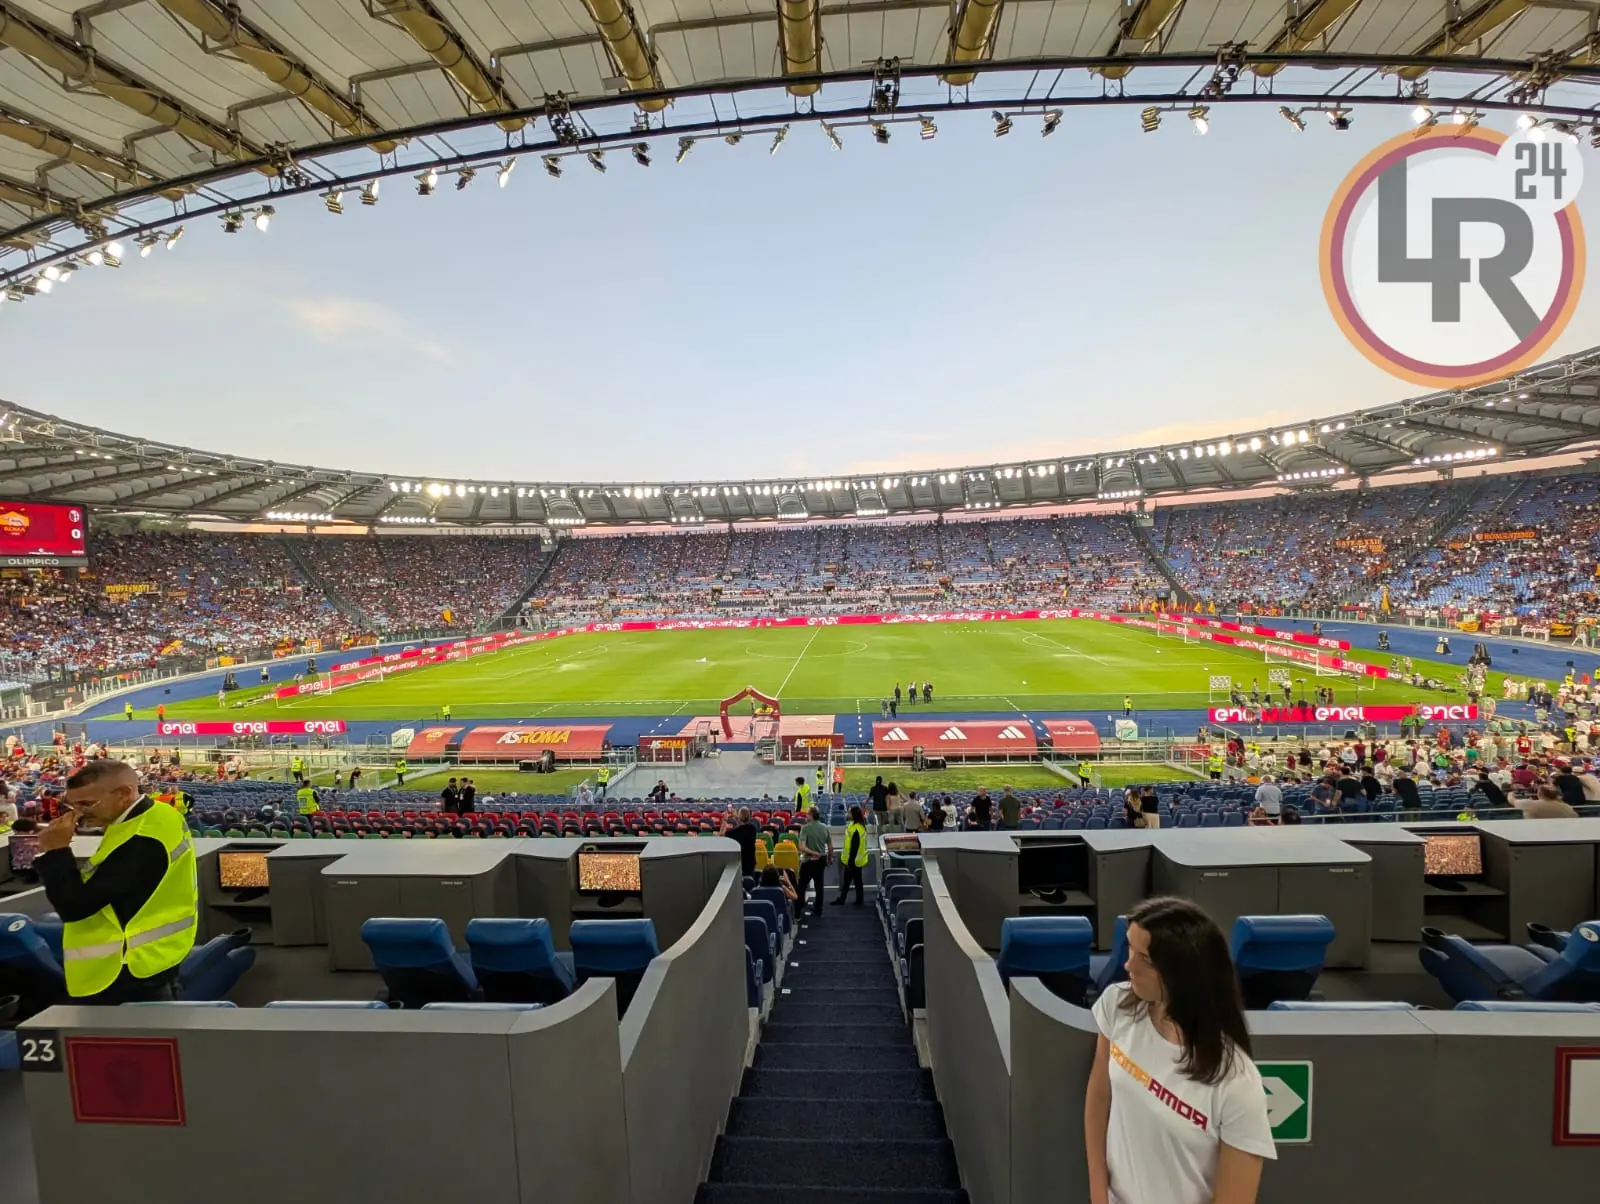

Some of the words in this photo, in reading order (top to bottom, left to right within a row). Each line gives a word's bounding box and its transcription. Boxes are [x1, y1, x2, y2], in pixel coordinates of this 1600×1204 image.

[1319, 638, 1340, 649] enel
[1316, 707, 1364, 720] enel
[1422, 705, 1470, 720] enel
[162, 722, 197, 734] enel
[233, 721, 268, 733] enel
[304, 720, 340, 732] enel
[22, 1039, 55, 1062] 23
